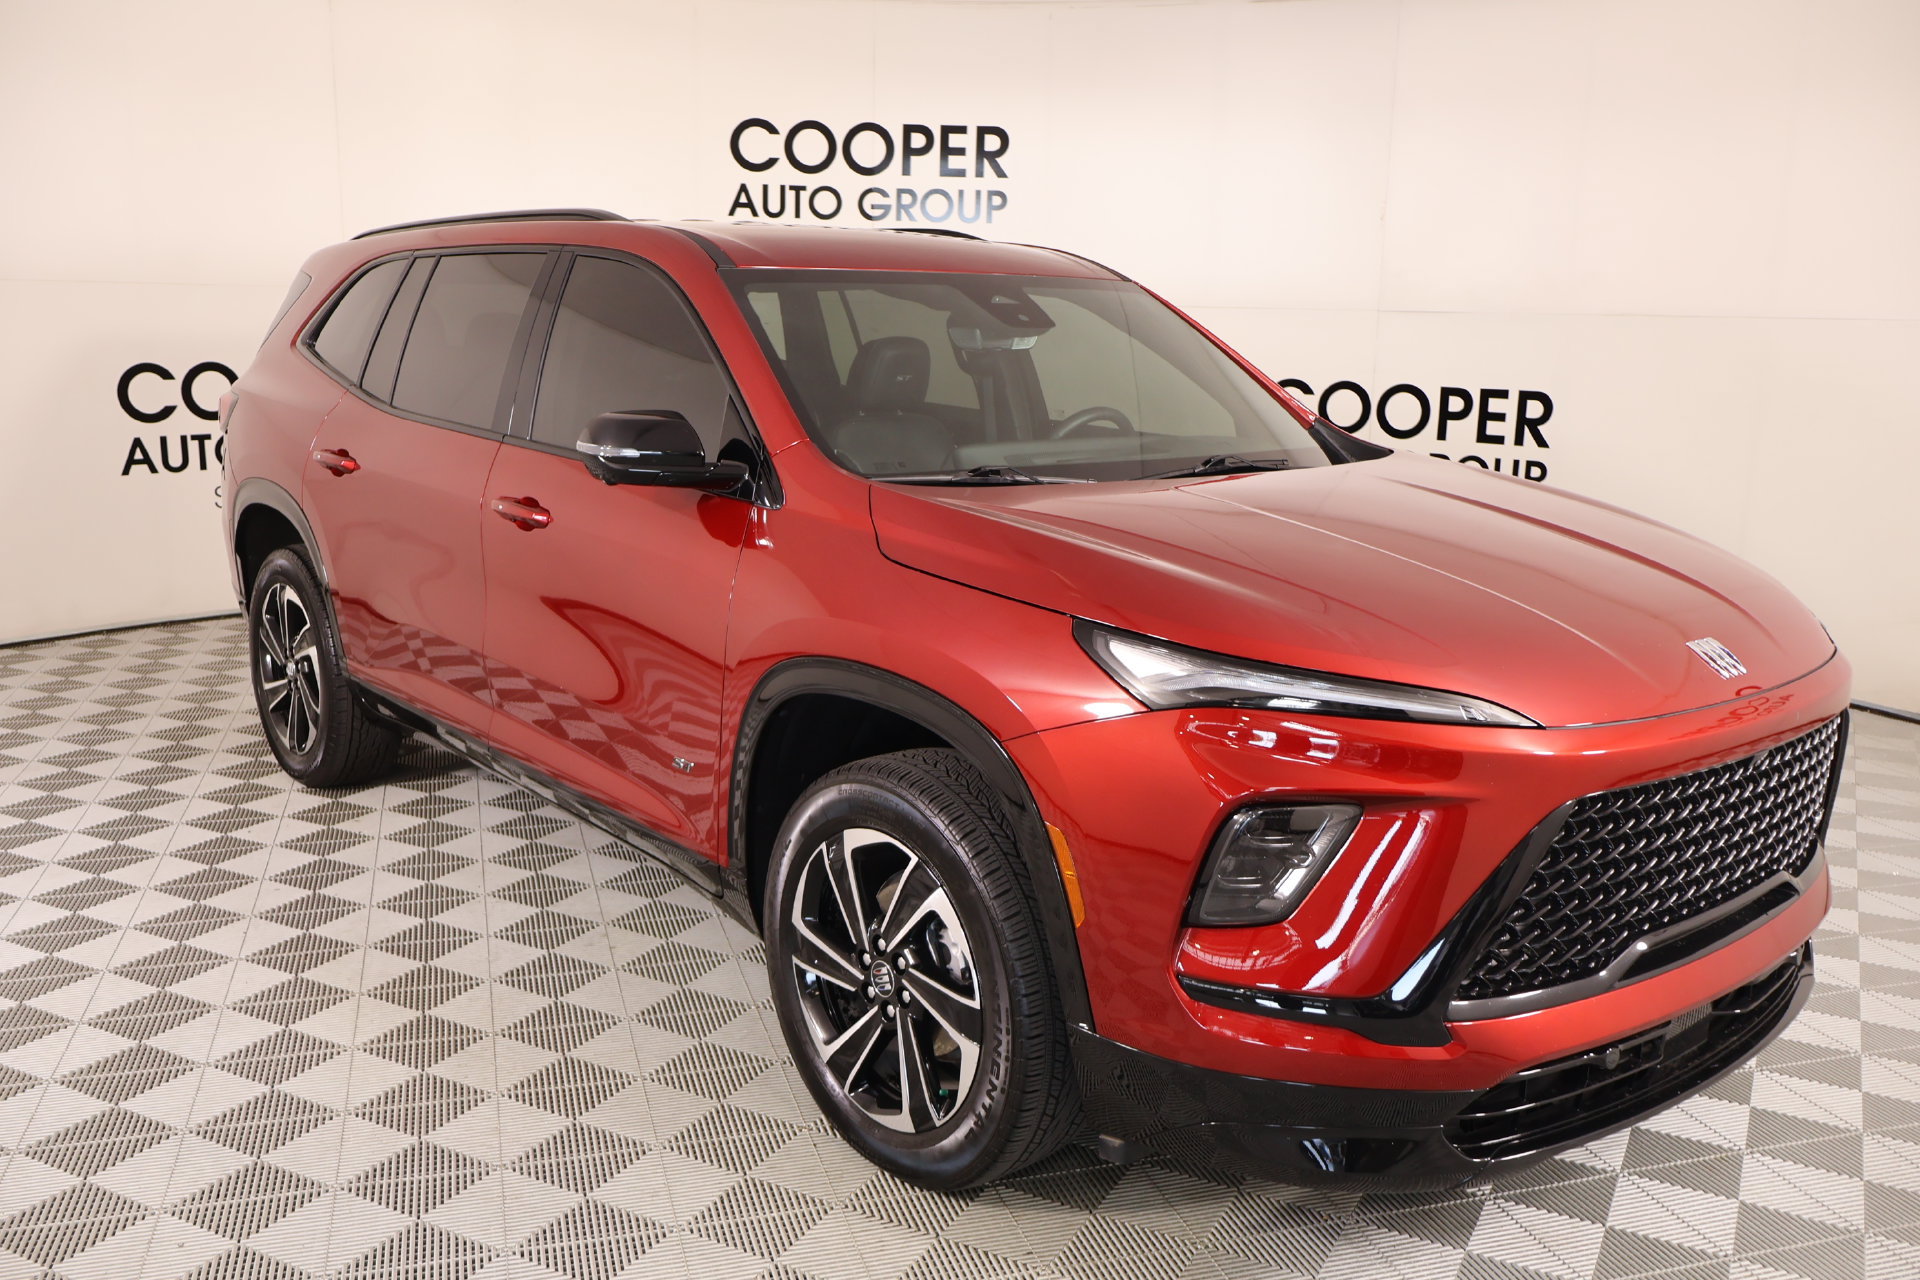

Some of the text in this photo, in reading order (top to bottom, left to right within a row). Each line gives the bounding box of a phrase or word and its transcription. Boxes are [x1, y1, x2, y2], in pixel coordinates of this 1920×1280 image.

[730, 118, 1010, 178] COOPER
[728, 183, 1008, 223] AUTO GROUP
